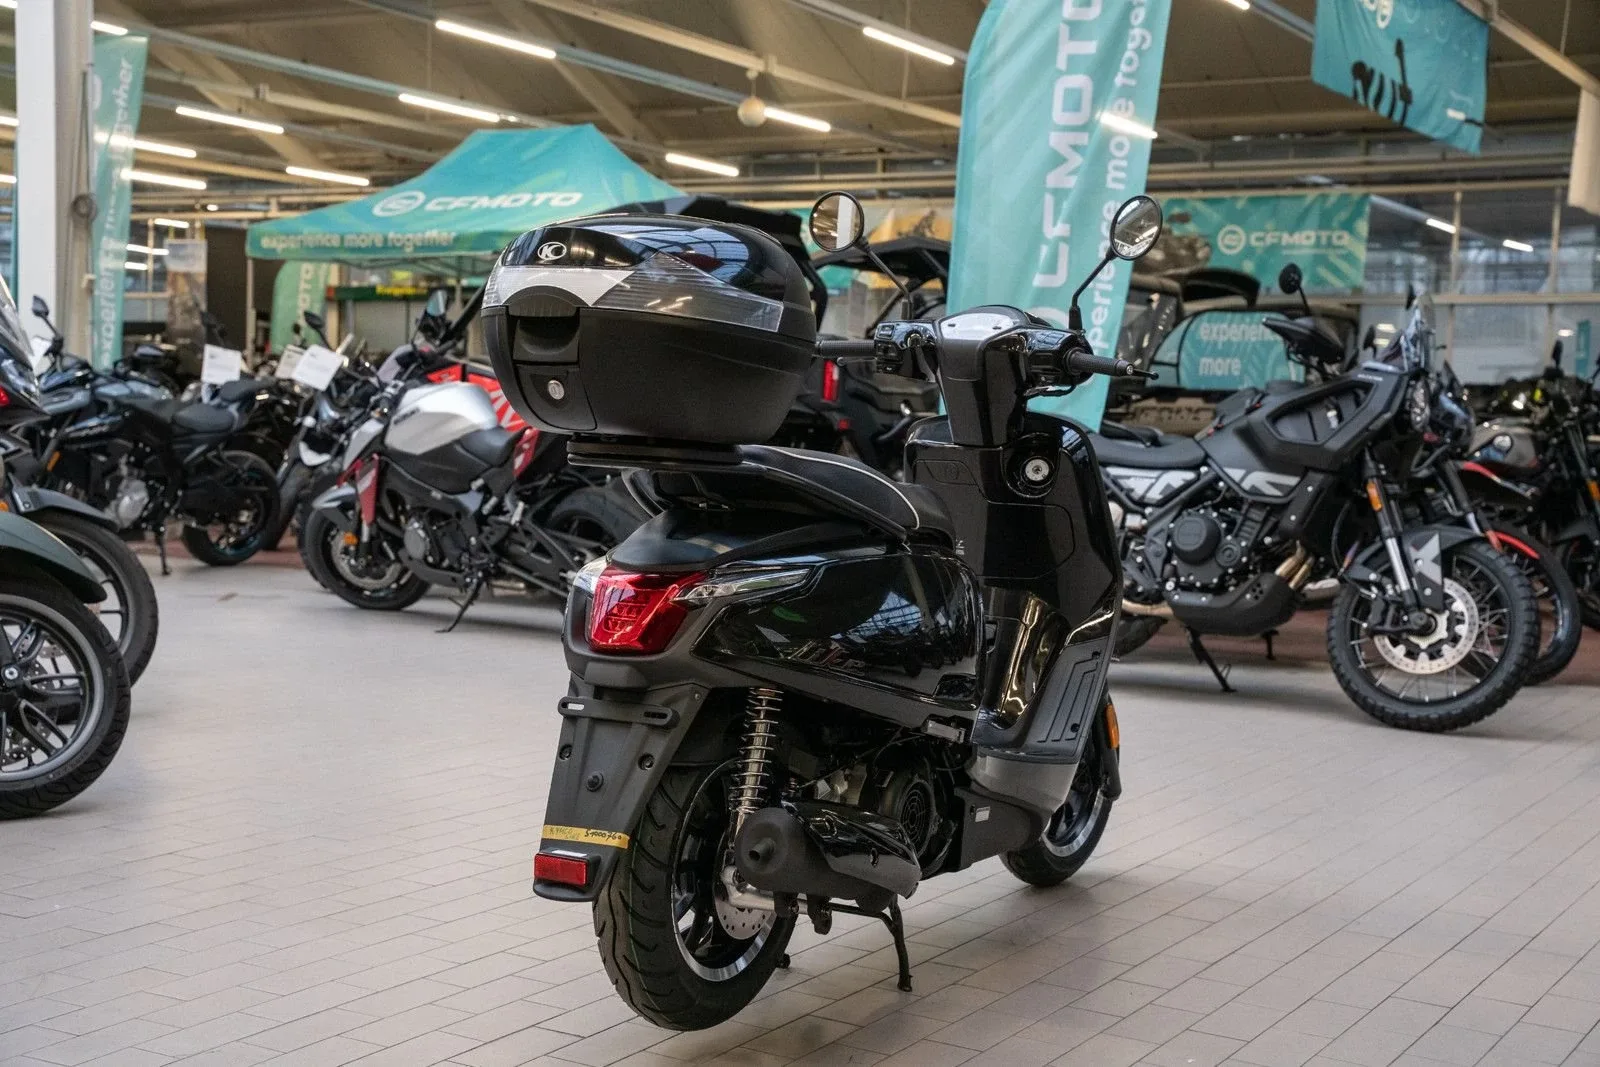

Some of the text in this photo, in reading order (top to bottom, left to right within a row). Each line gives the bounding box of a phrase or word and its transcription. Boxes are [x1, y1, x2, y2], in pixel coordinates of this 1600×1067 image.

[1105, 97, 1135, 190] moe
[424, 192, 583, 211] CFMOTO
[344, 233, 384, 248] more
[1250, 230, 1351, 246] CFMOTO
[1200, 357, 1241, 376] more
